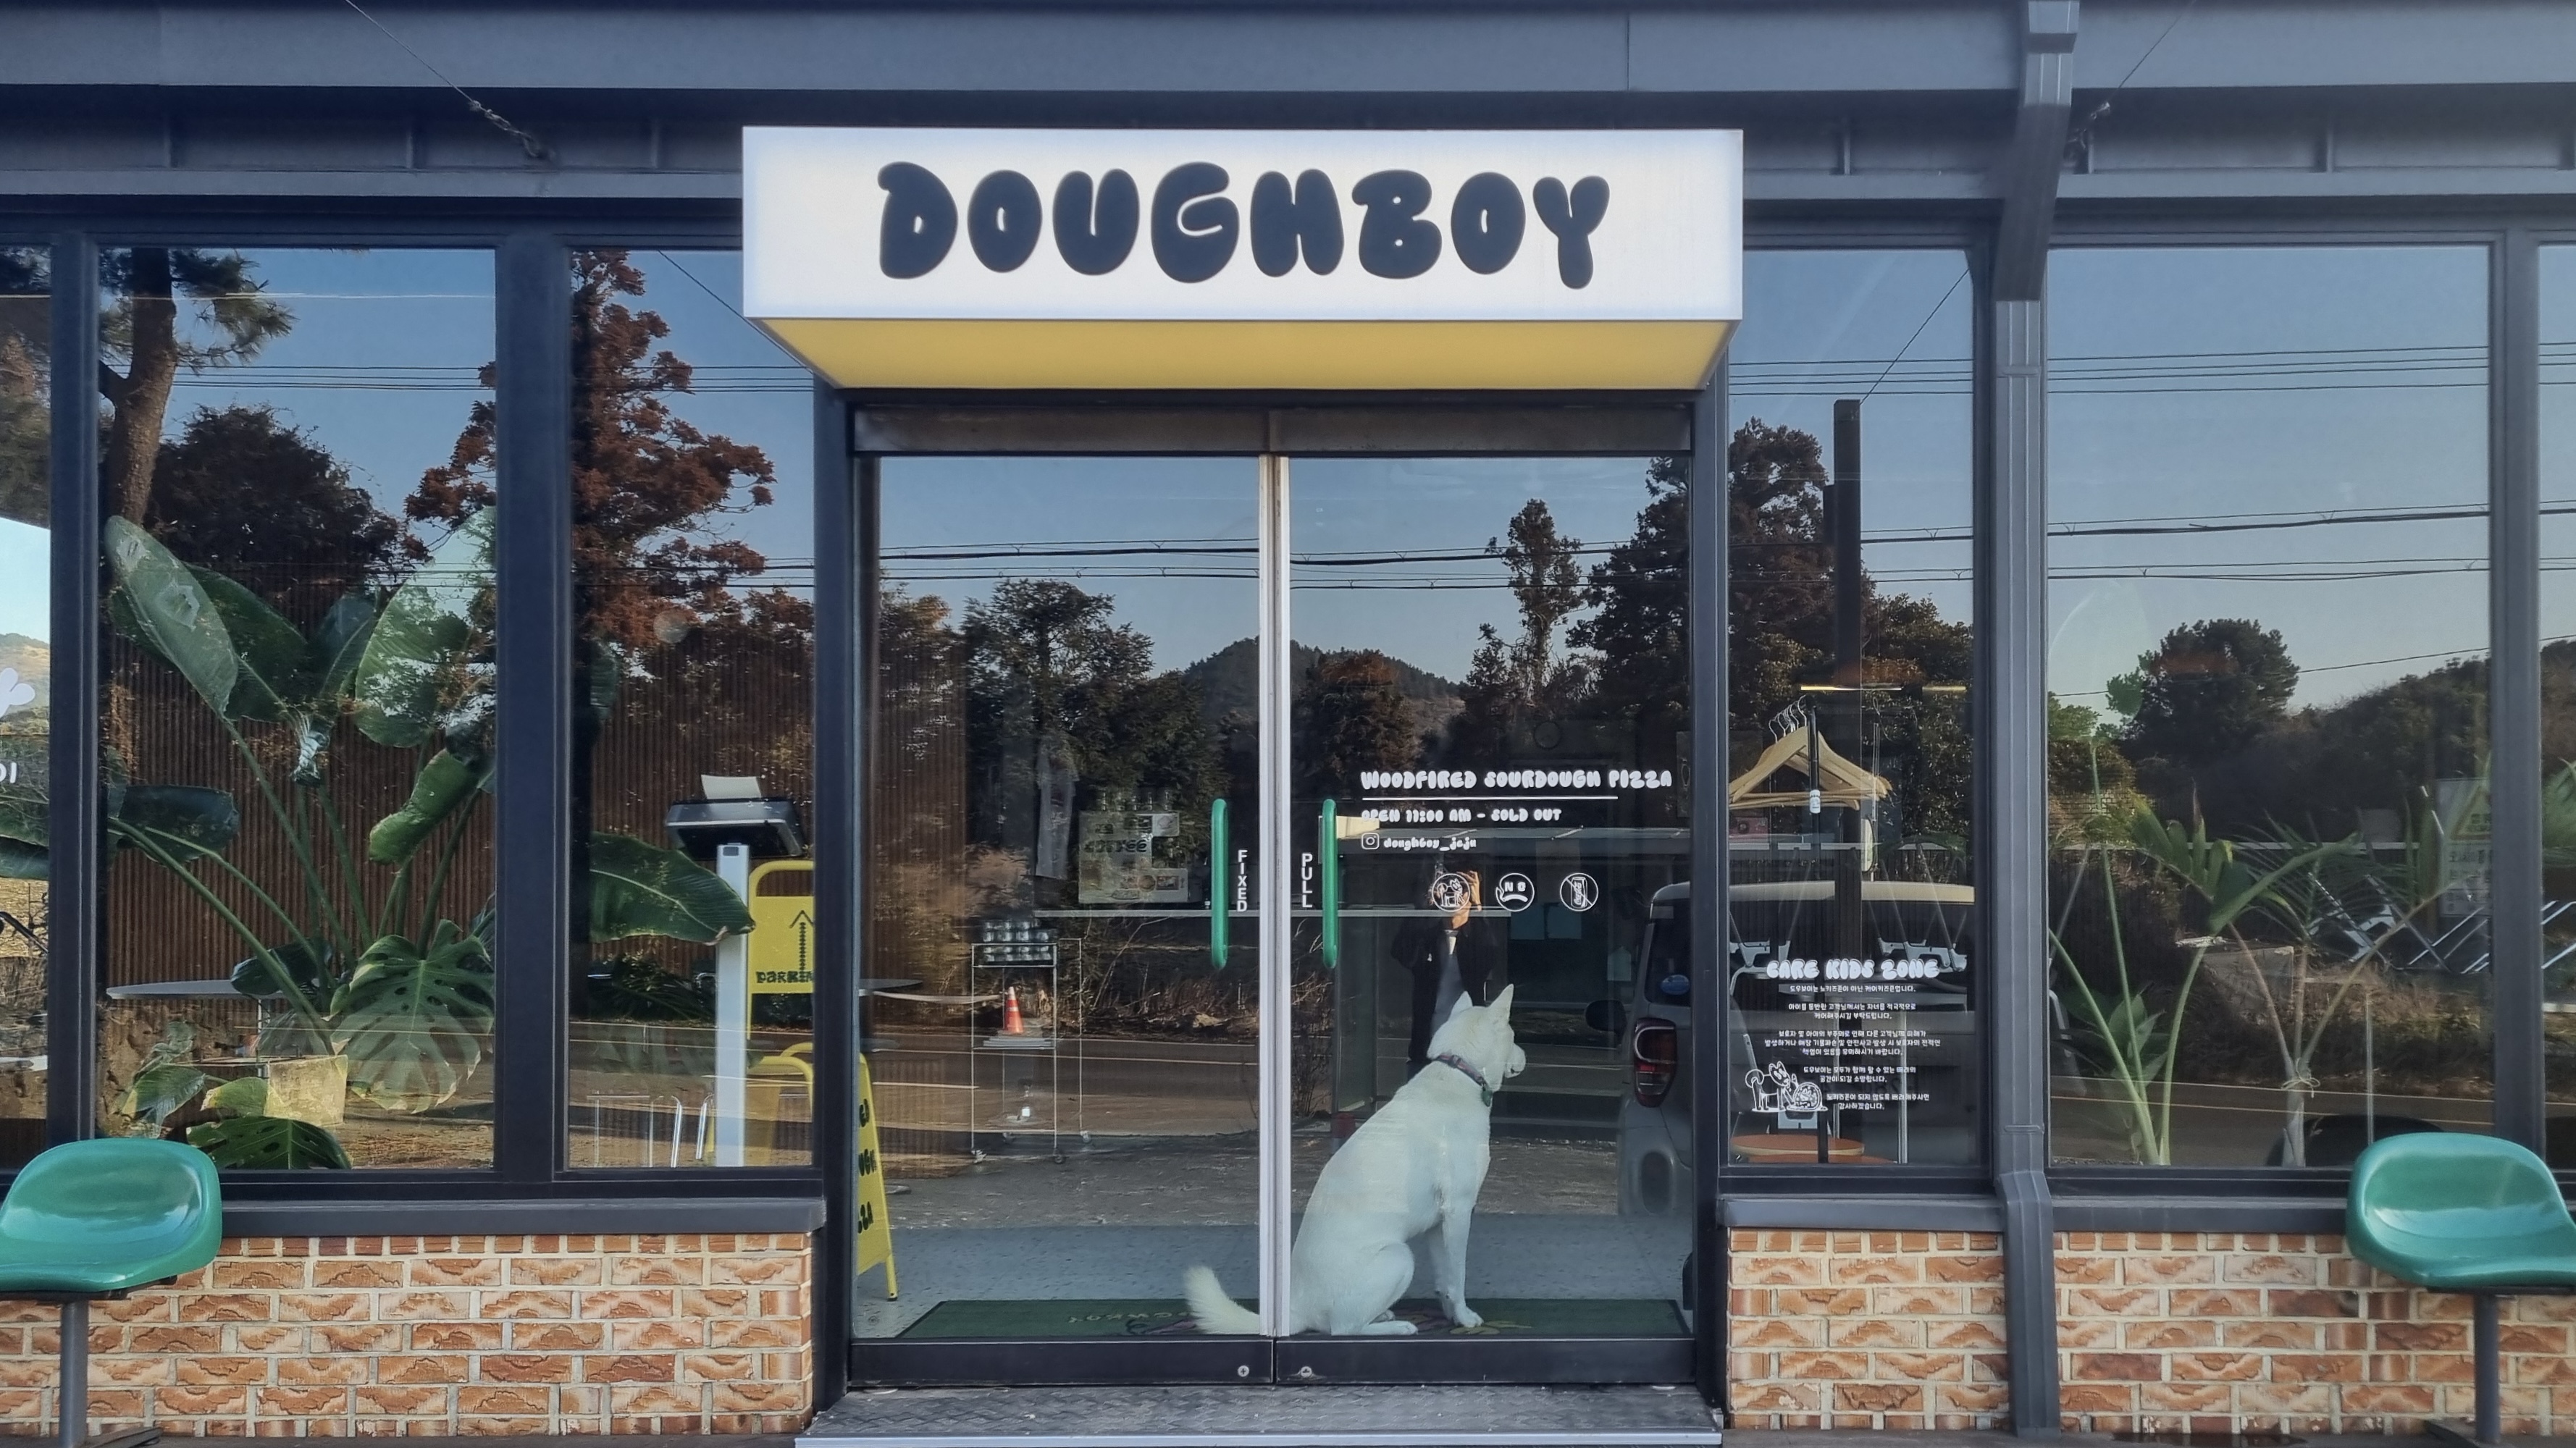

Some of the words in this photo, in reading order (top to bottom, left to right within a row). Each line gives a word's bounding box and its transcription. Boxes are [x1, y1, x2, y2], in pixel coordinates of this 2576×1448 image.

[877, 161, 1610, 290] DOUGHBOY
[1361, 770, 1477, 791] WOODFIRED
[1484, 770, 1601, 789] SOURDOUGH
[1608, 770, 1672, 789] PIZZA
[1362, 809, 1401, 822] OPEN
[1406, 809, 1444, 822] 11:00
[1449, 808, 1472, 822] AM
[1491, 808, 1529, 822] SOLD
[1534, 809, 1562, 821] OUT
[1236, 849, 1249, 912] FIXED
[1301, 853, 1313, 909] PULL
[1766, 959, 1820, 979] CARE
[1826, 959, 1875, 980] KIDS
[1881, 959, 1941, 980] ZONE
